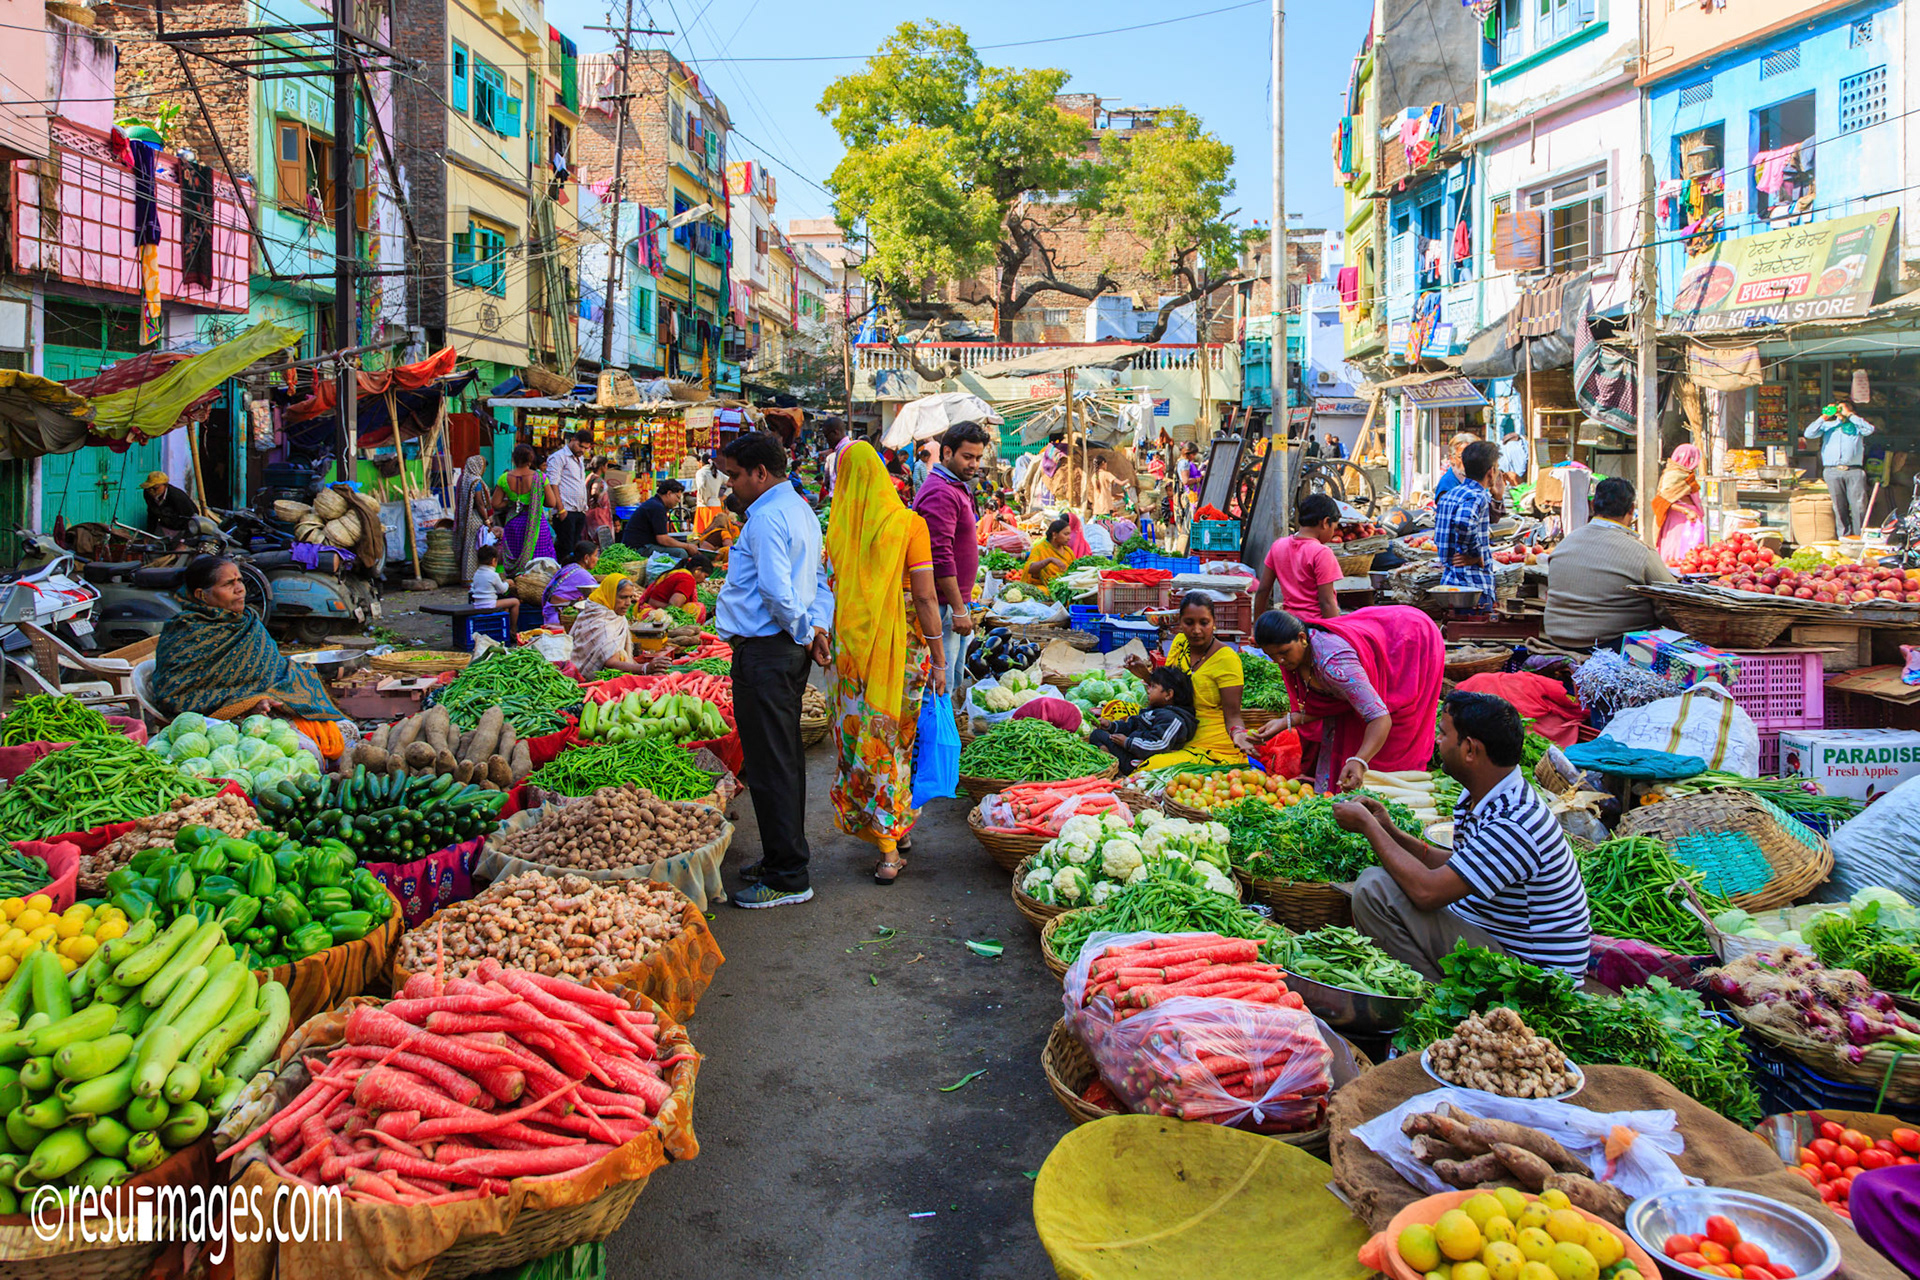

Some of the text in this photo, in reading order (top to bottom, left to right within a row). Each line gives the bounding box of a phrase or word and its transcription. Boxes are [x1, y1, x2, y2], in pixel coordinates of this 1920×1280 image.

[1748, 240, 1777, 258] टेस्ट
[1780, 232, 1795, 249] में
[1795, 230, 1831, 249] बेस्ट
[1738, 275, 1808, 302] EVEREST
[1792, 296, 1856, 319] STORE
[1823, 746, 1920, 764] PARADISE
[1827, 765, 1899, 779] Fresh Apples
